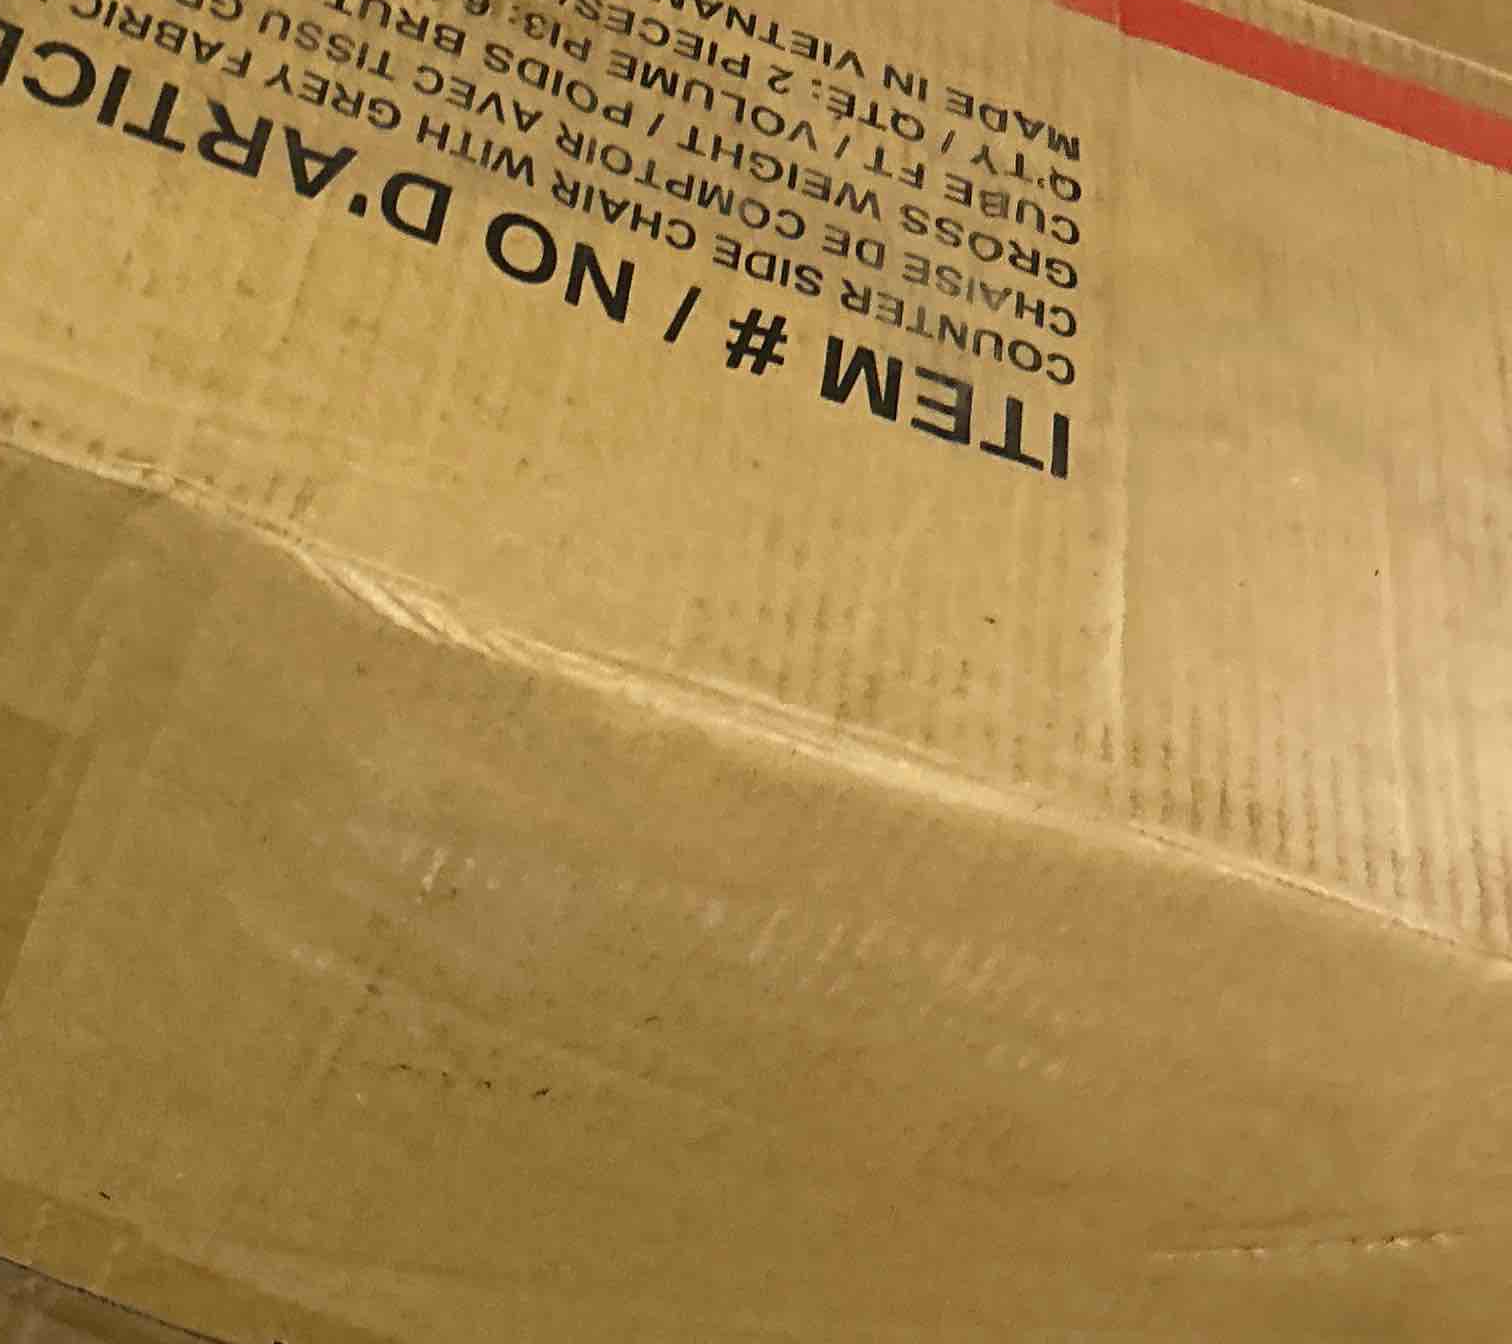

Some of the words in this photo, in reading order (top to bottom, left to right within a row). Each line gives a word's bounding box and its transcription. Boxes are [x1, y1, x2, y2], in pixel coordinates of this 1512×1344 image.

[257, 8, 395, 82] TISSU
[766, 63, 794, 95] 2
[263, 62, 402, 131] GREY
[411, 63, 544, 134] AVEC
[482, 41, 634, 129] POIDS
[606, 48, 817, 151] VOLUME
[810, 77, 926, 142] QTÉ:
[881, 63, 929, 103] IN
[415, 113, 535, 188] WITH
[645, 111, 666, 138] /
[832, 133, 851, 160] /
[939, 128, 956, 155] /
[944, 85, 1080, 162] MADE
[554, 119, 806, 240] COMPTOIR
[675, 123, 881, 222] WEIGHT
[862, 144, 925, 190] FT
[969, 142, 1082, 203] Q'TY
[550, 168, 697, 251] CHAIR
[943, 171, 1081, 246] CUBE
[484, 211, 636, 324] NO
[711, 233, 824, 297] SIDE
[820, 222, 886, 270] DE
[898, 203, 1079, 290] GROSS
[662, 284, 702, 344] /
[901, 251, 1077, 338] CHAISE
[724, 306, 788, 376] #
[839, 276, 1076, 386] COUNTER
[819, 333, 1070, 480] ITEM
